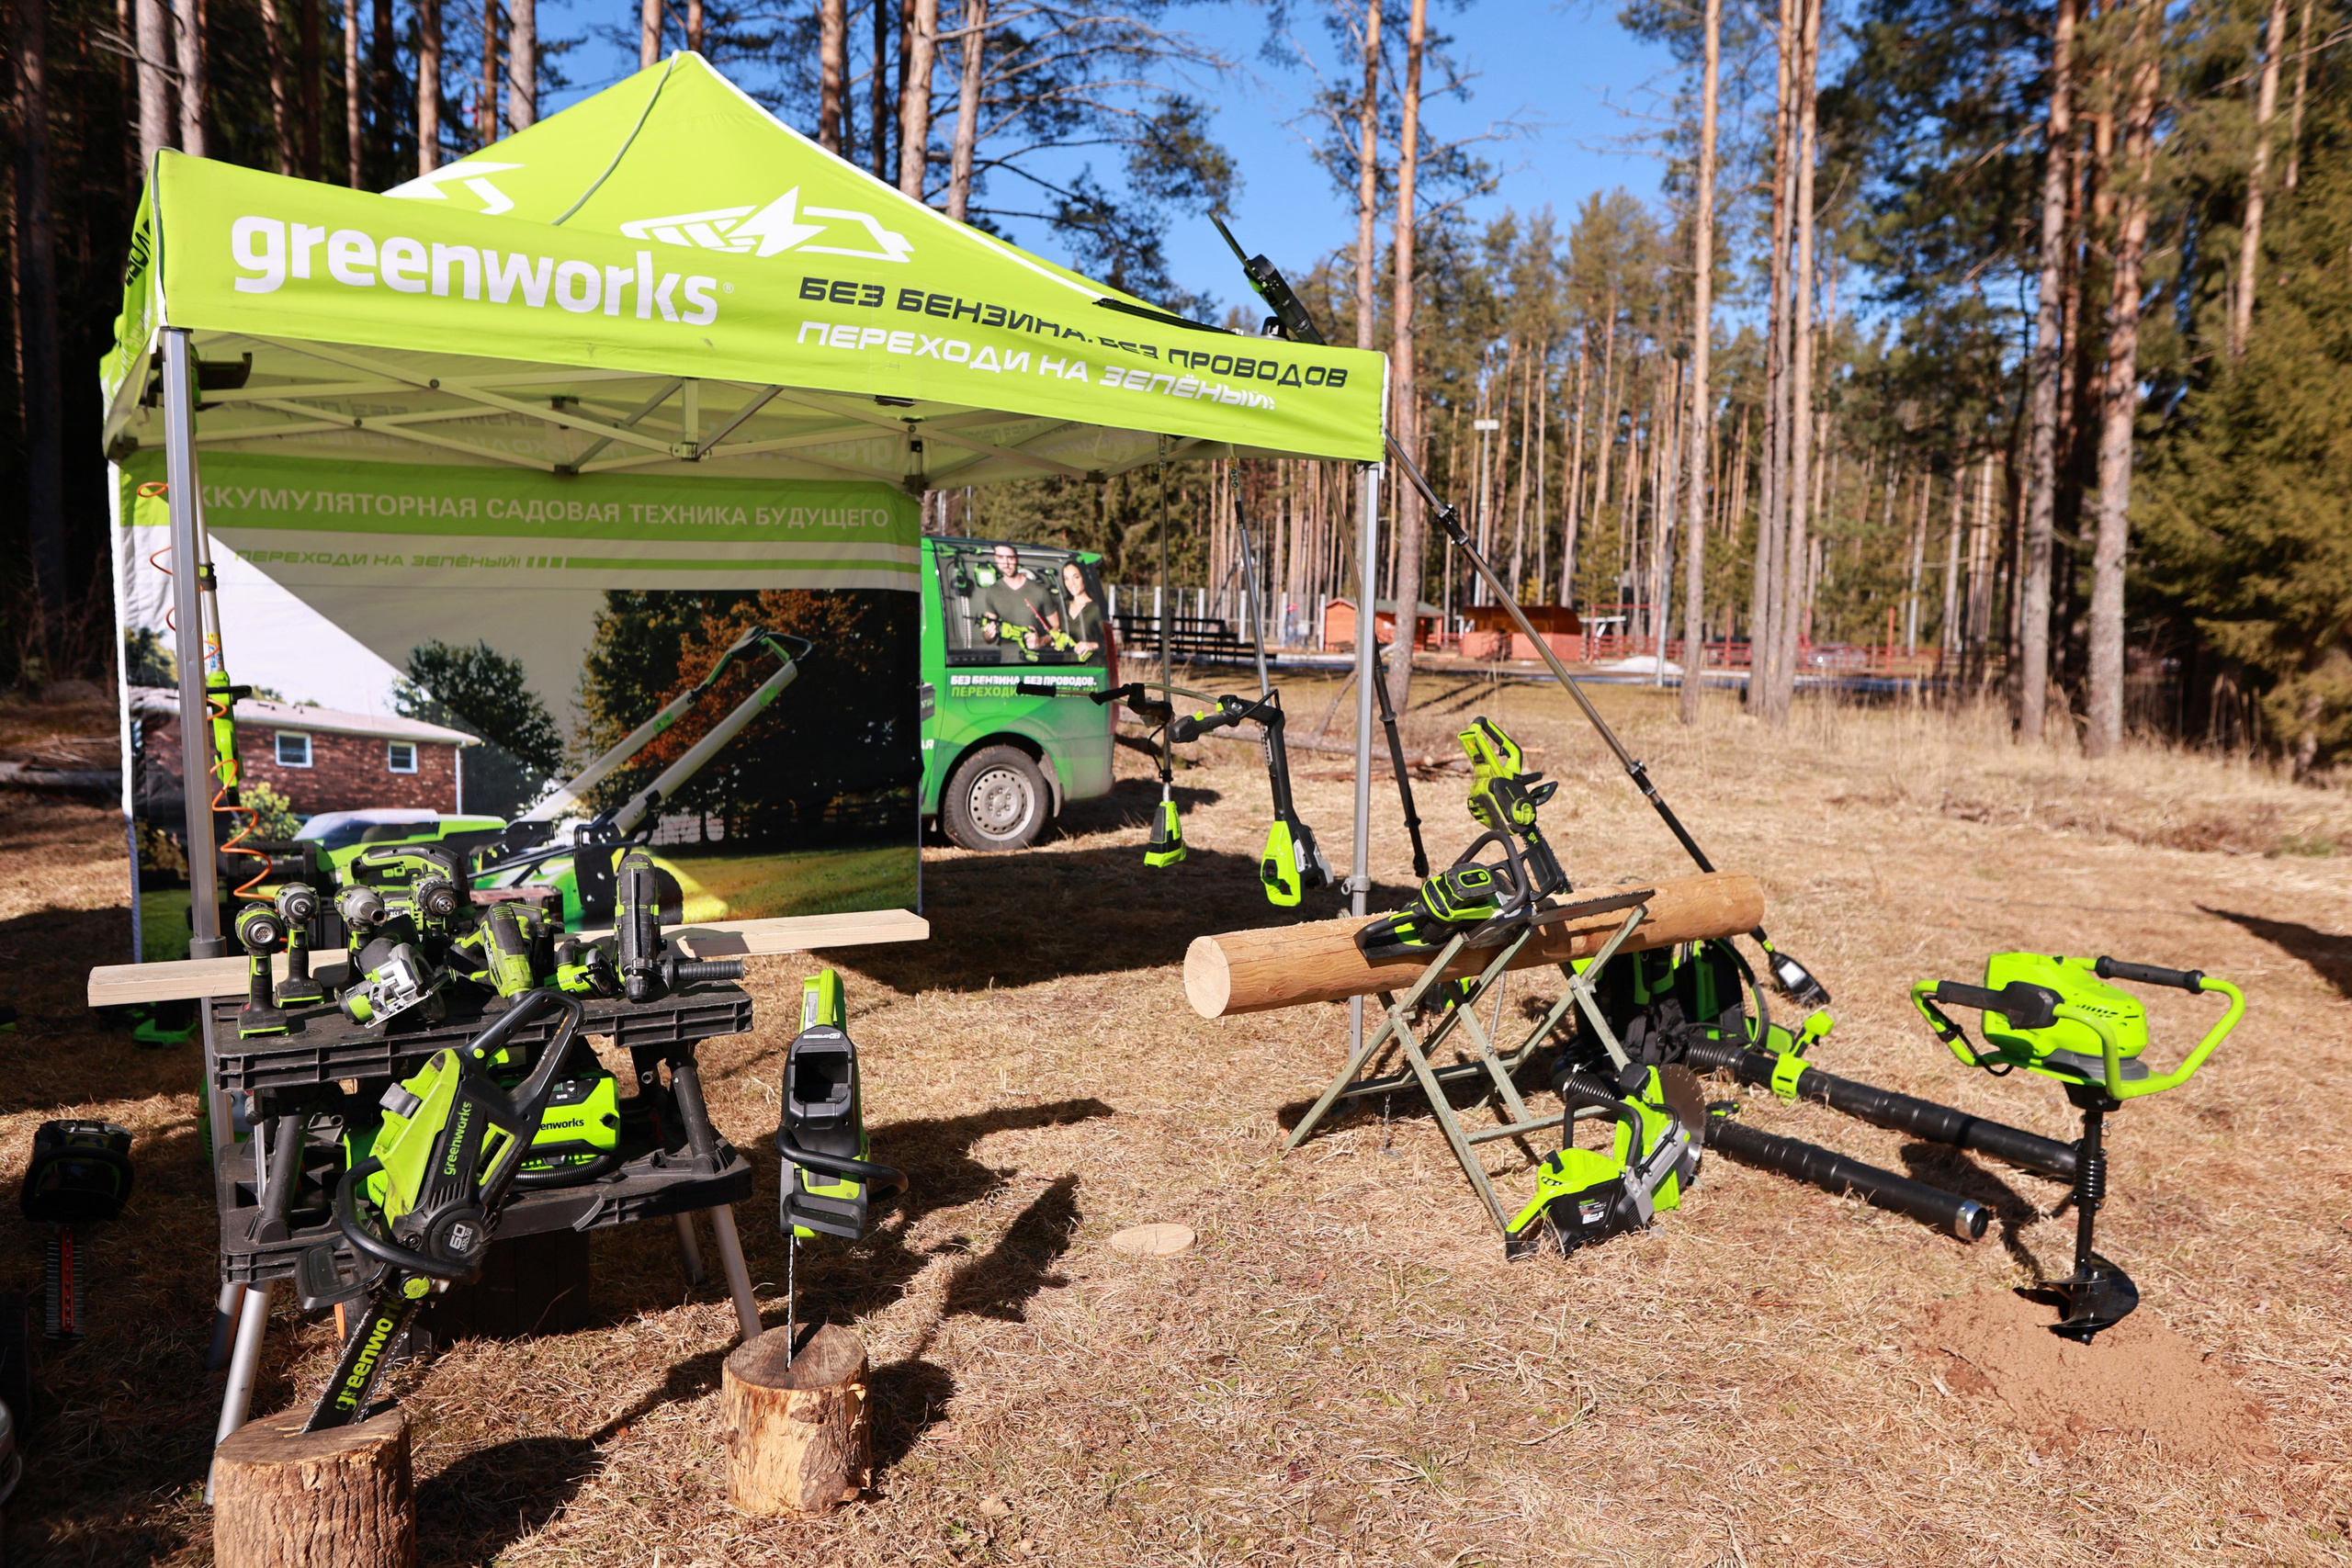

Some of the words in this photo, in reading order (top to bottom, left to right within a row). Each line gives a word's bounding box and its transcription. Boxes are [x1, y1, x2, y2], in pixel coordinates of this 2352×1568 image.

[231, 215, 718, 326] greenworks
[798, 276, 886, 308] БЕЗ
[1168, 347, 1349, 388] ПРОВОДОВ
[796, 321, 1031, 374] ПЕРЕХОДИ
[1038, 355, 1089, 383] НА
[1098, 366, 1275, 411] ЗЕЛЁНЫЙ!
[198, 485, 478, 520] ККУМУЛЯТОРНАЯ
[486, 499, 620, 525] САДОВАЯ
[628, 503, 749, 526] ТЕХНИКА
[755, 506, 889, 530] БУДУЩЕГО
[234, 548, 368, 568] ПЕРЕХОДИ
[373, 553, 406, 567] НА
[950, 675, 971, 685] БЕЗ
[1023, 676, 1043, 685] БЕЗ
[1043, 676, 1097, 687] ПРОВОДОВ.
[443, 1101, 472, 1177] greenworks
[539, 1117, 584, 1131] enworks
[448, 1223, 467, 1250] 60
[334, 1295, 406, 1412] greenwork
